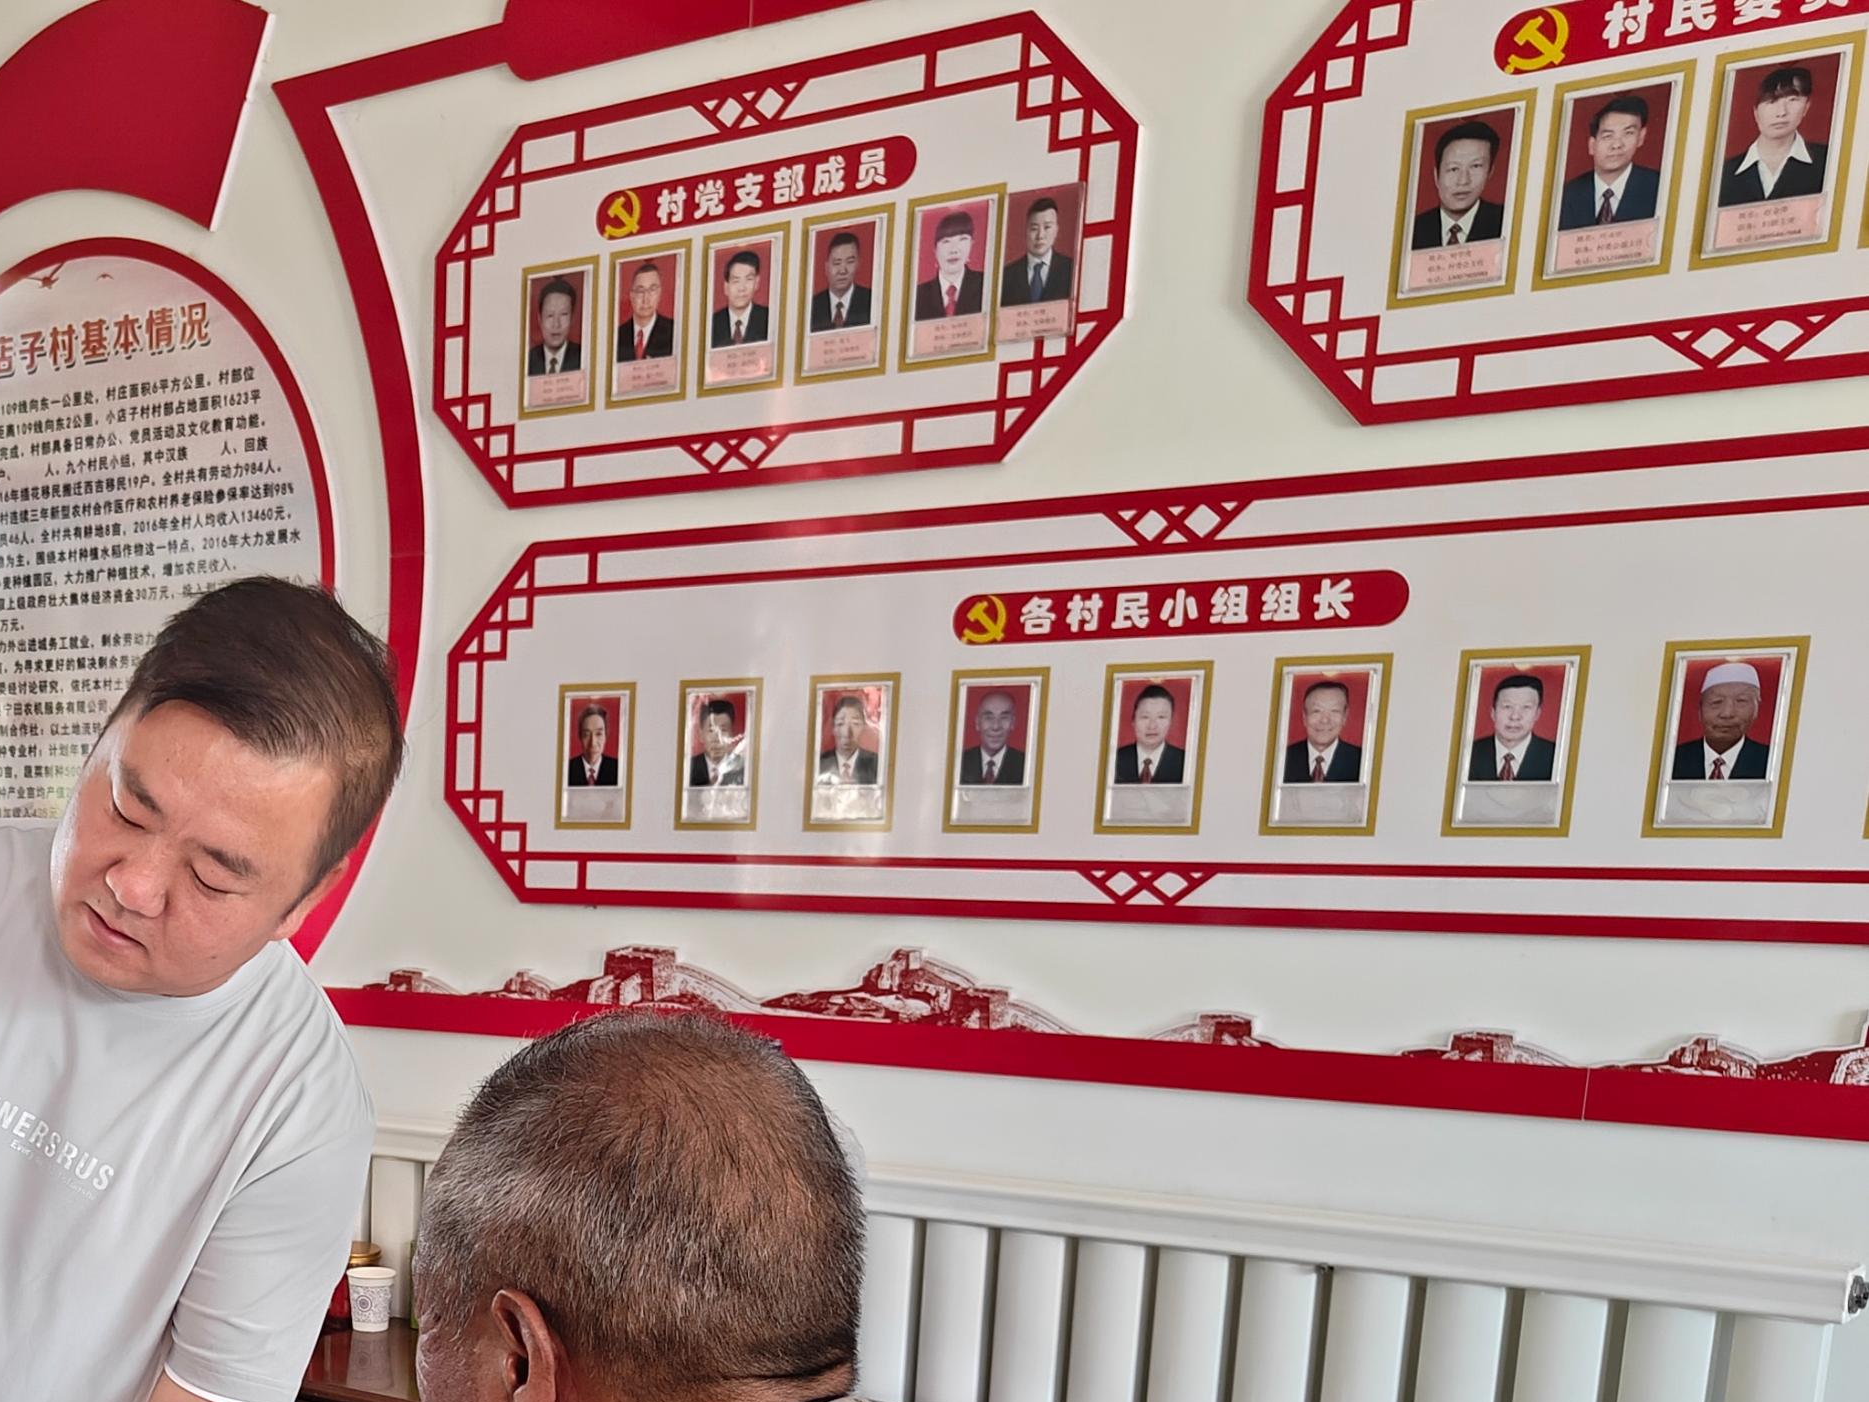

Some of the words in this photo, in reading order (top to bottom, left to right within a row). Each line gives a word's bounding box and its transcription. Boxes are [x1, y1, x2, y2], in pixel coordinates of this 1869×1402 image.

[656, 147, 887, 227] 村党支部成员
[1020, 578, 1354, 635] 各村民小组组长
